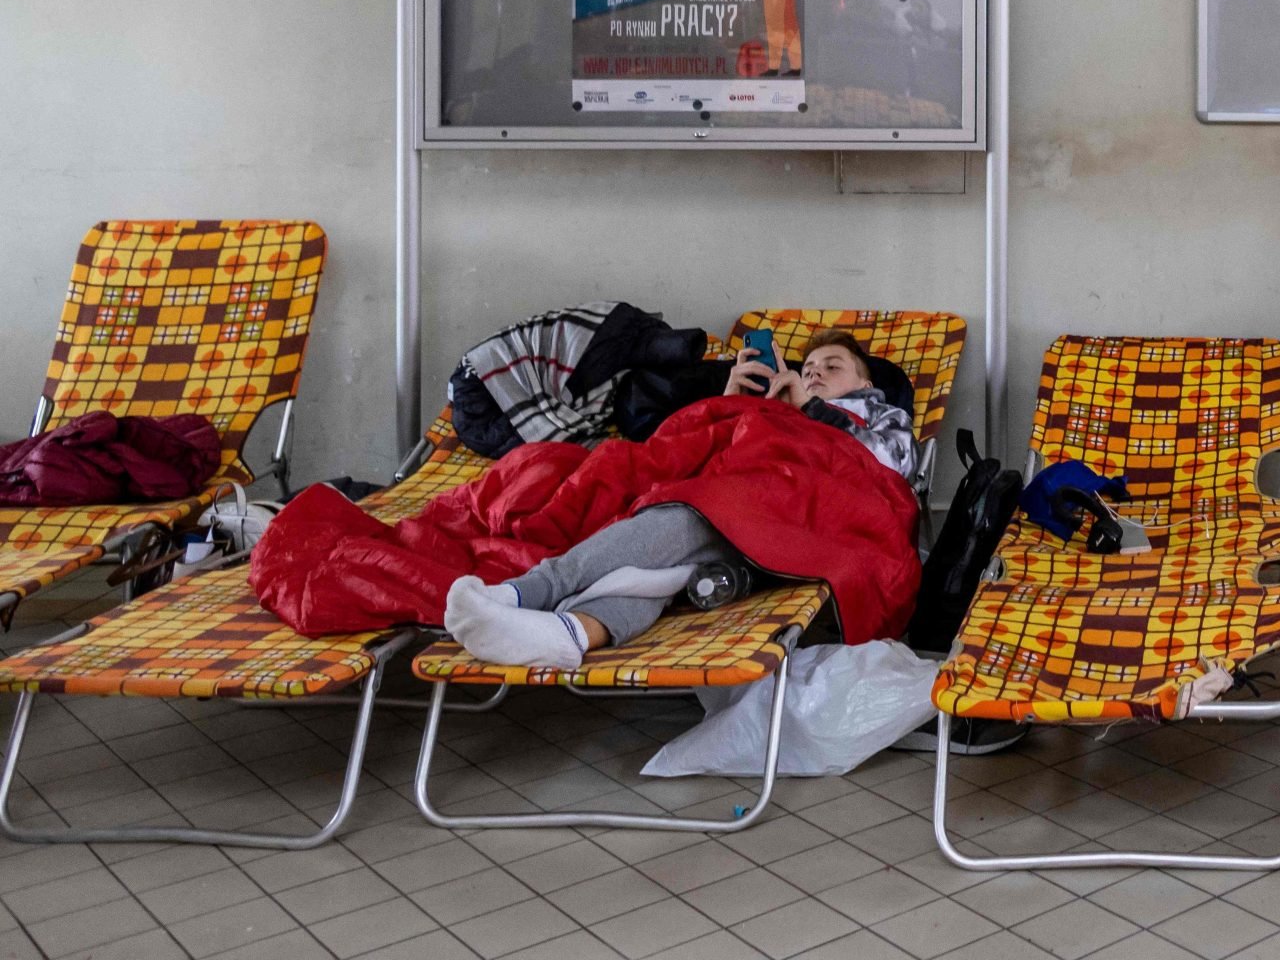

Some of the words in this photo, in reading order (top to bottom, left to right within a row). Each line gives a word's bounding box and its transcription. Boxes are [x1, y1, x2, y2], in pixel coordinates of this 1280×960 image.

[610, 19, 622, 37] PO
[626, 20, 656, 37] RYNKU
[660, 3, 738, 38] PRACY?
